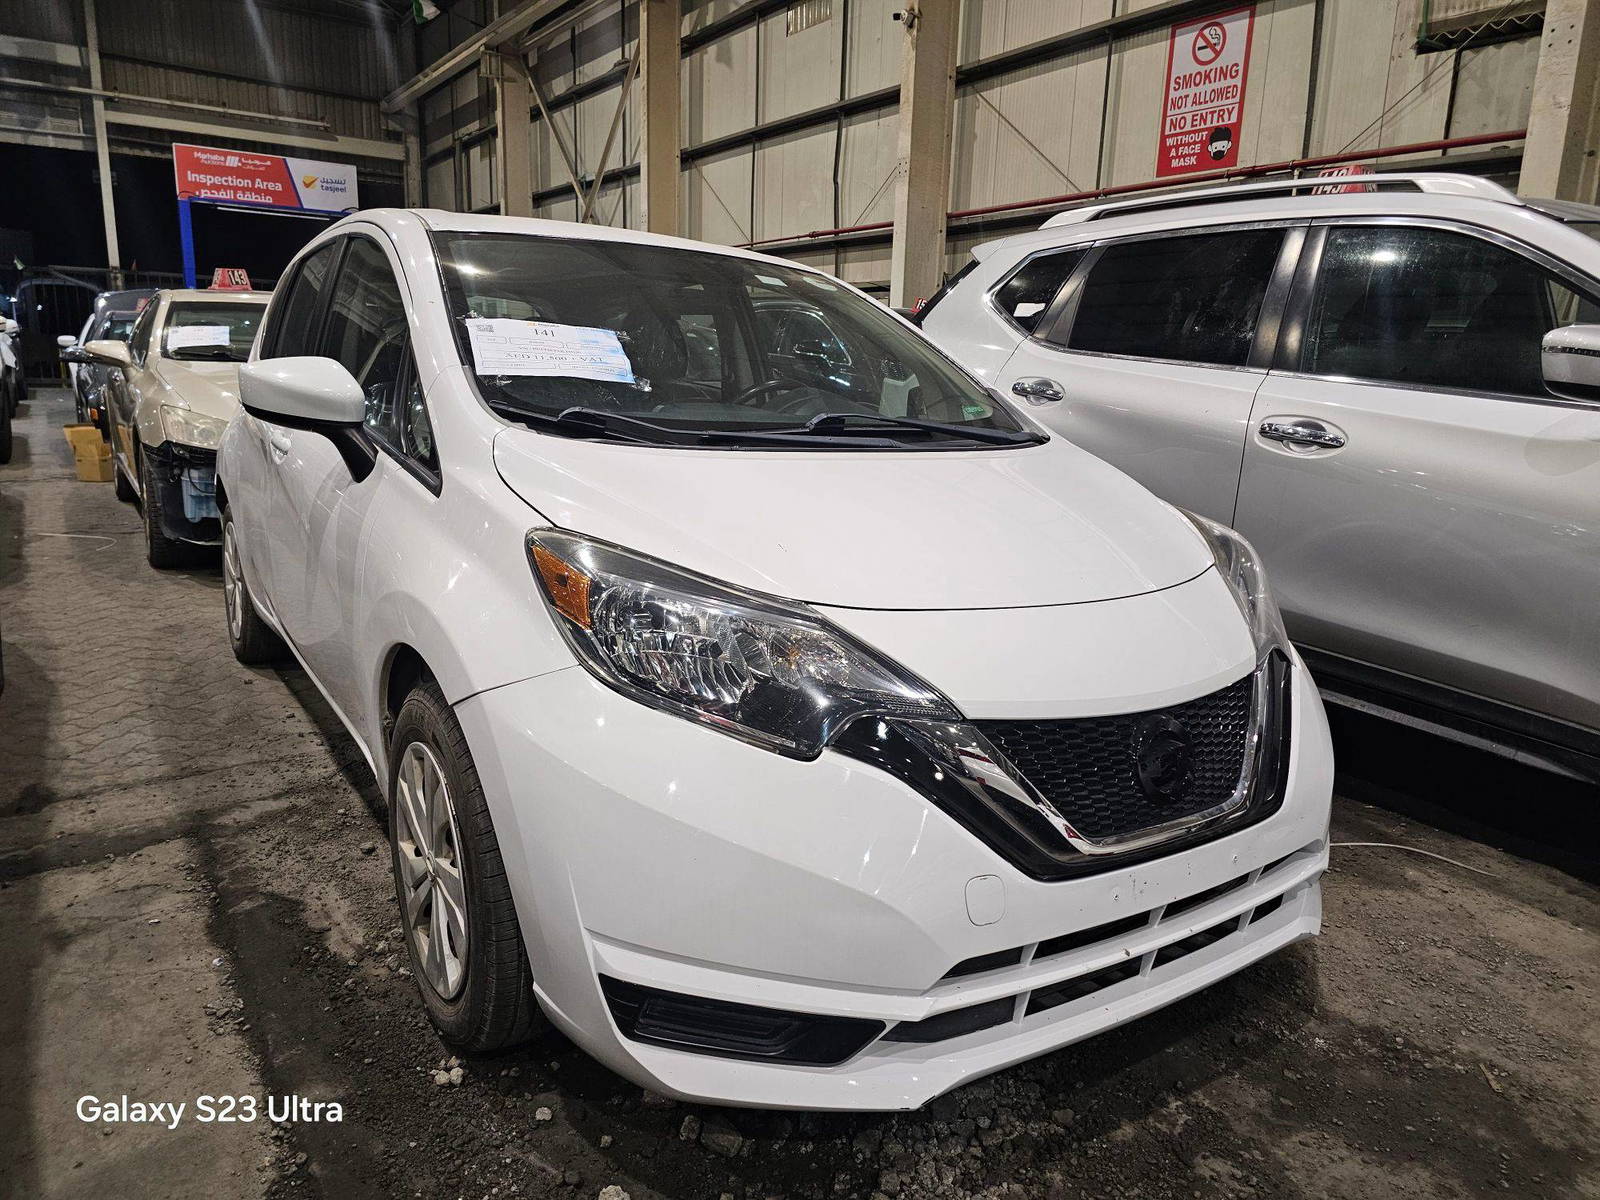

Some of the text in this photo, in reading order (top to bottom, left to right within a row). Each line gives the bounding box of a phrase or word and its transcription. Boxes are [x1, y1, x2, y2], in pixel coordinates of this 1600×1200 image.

[1173, 62, 1240, 92] SMOKING
[1169, 84, 1239, 112] NOT ALLOWED
[1168, 106, 1235, 133] NO ENTRY
[1166, 131, 1208, 147] WITHOUT
[1169, 144, 1201, 158] A FACE
[1171, 156, 1197, 168] MASK
[187, 170, 283, 191] Inspection Area
[321, 184, 347, 193] tasjeel
[236, 190, 273, 203] منطقة
[228, 269, 248, 286] 143
[534, 328, 555, 337] 141
